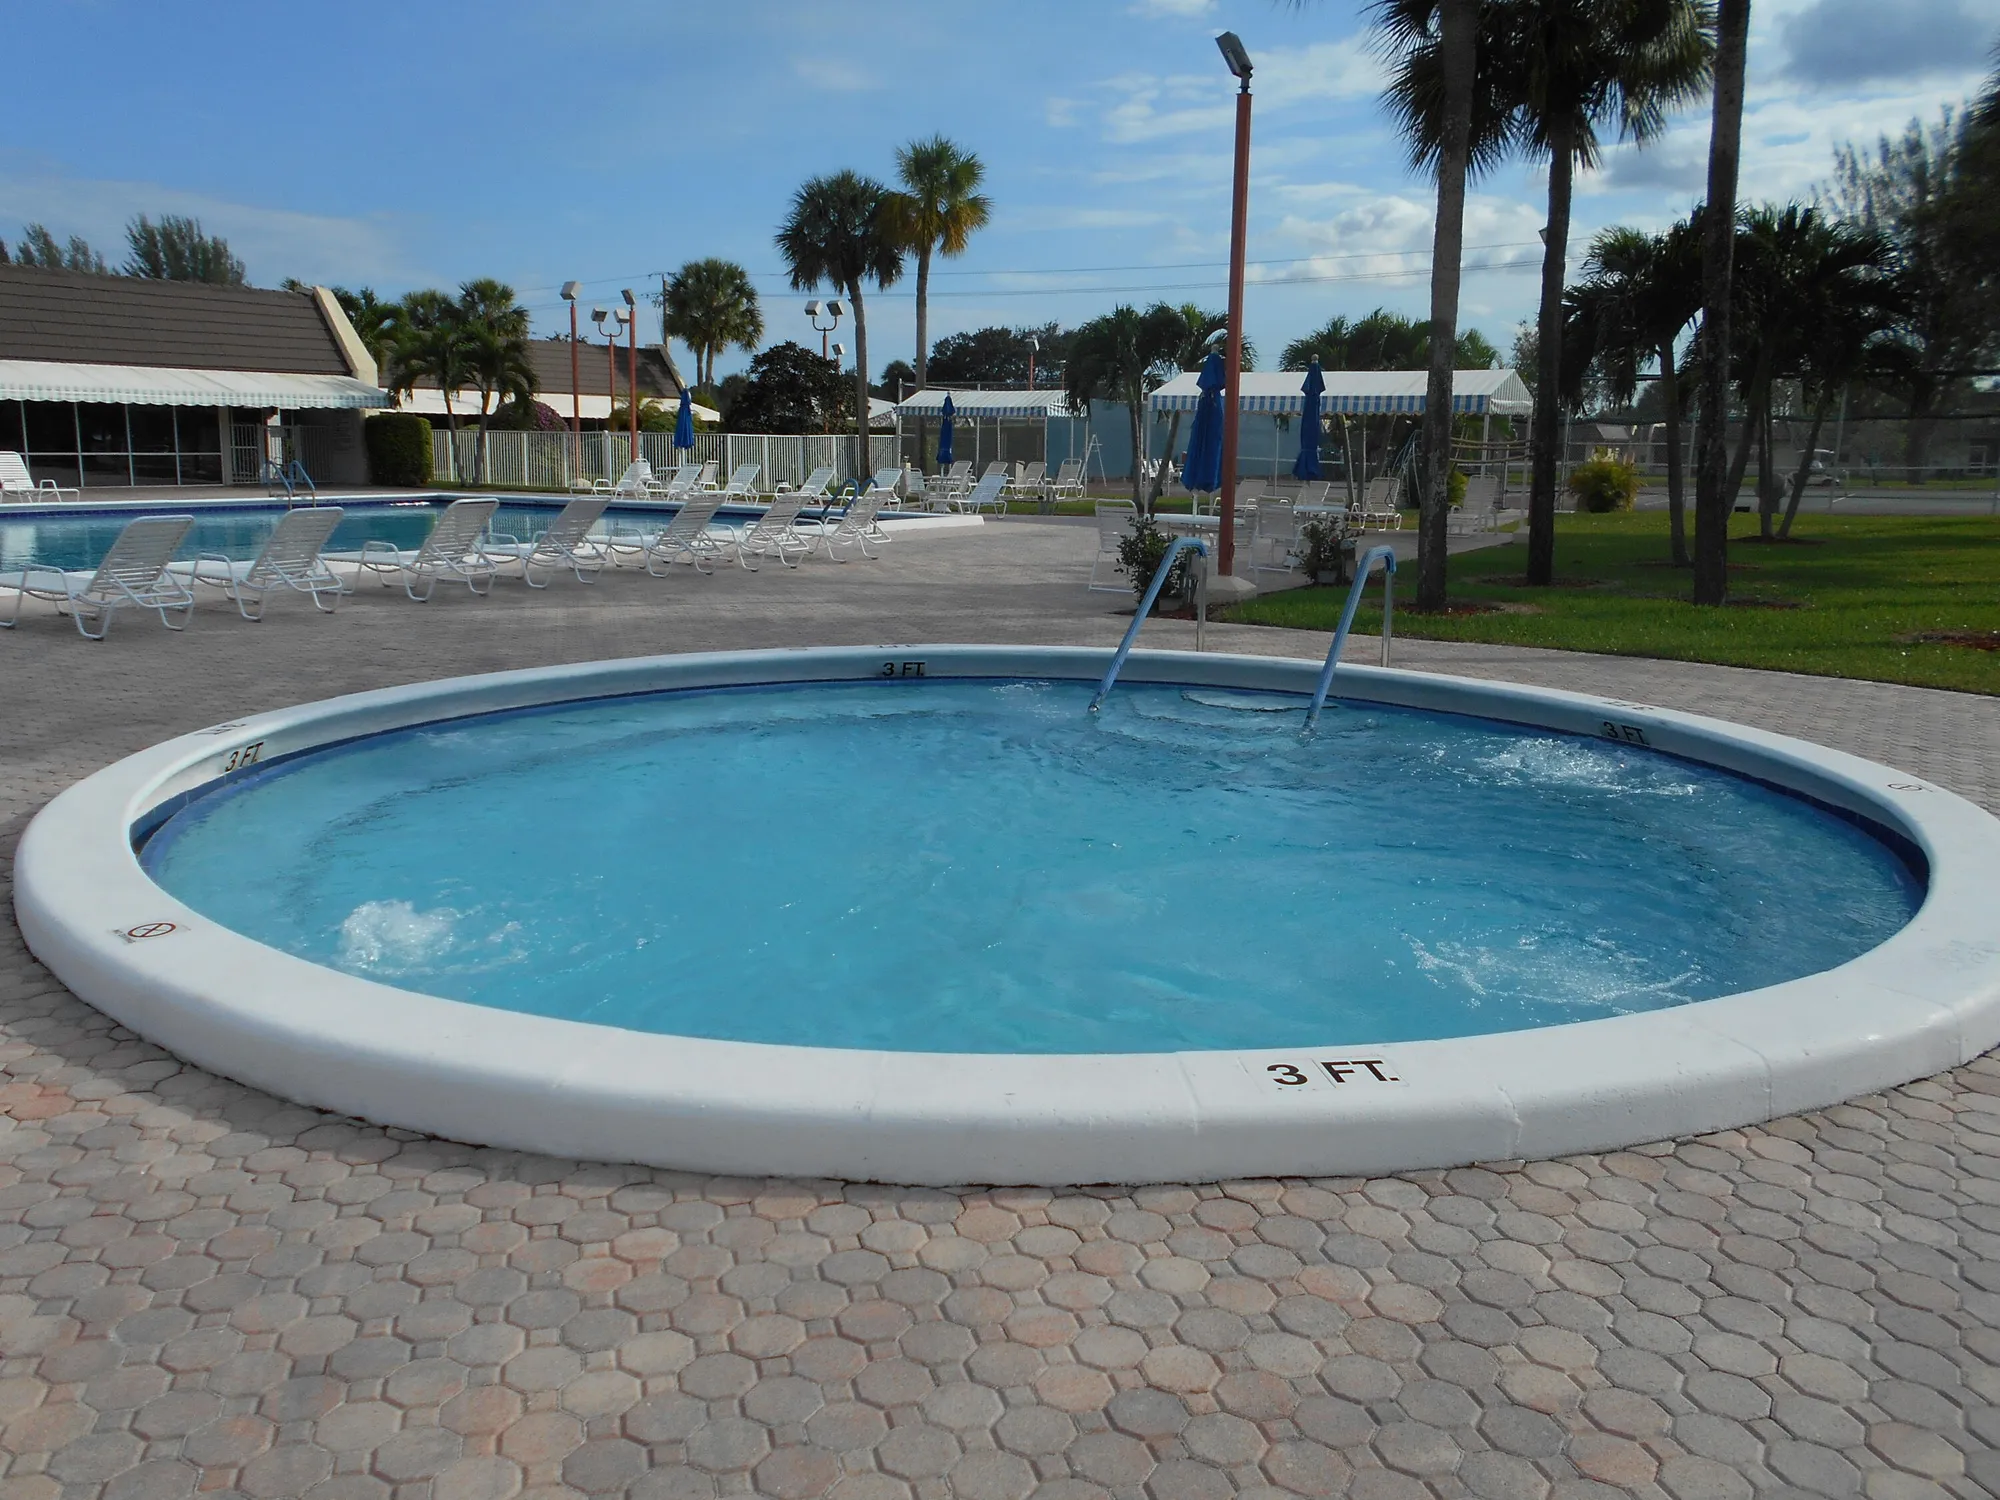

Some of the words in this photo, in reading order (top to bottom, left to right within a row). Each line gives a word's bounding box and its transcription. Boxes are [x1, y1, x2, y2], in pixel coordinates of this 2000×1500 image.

[882, 662, 895, 677] 3
[1603, 721, 1619, 738] 3
[225, 751, 239, 772] 3
[1266, 1064, 1309, 1086] 3
[1320, 1060, 1401, 1083] FT.
